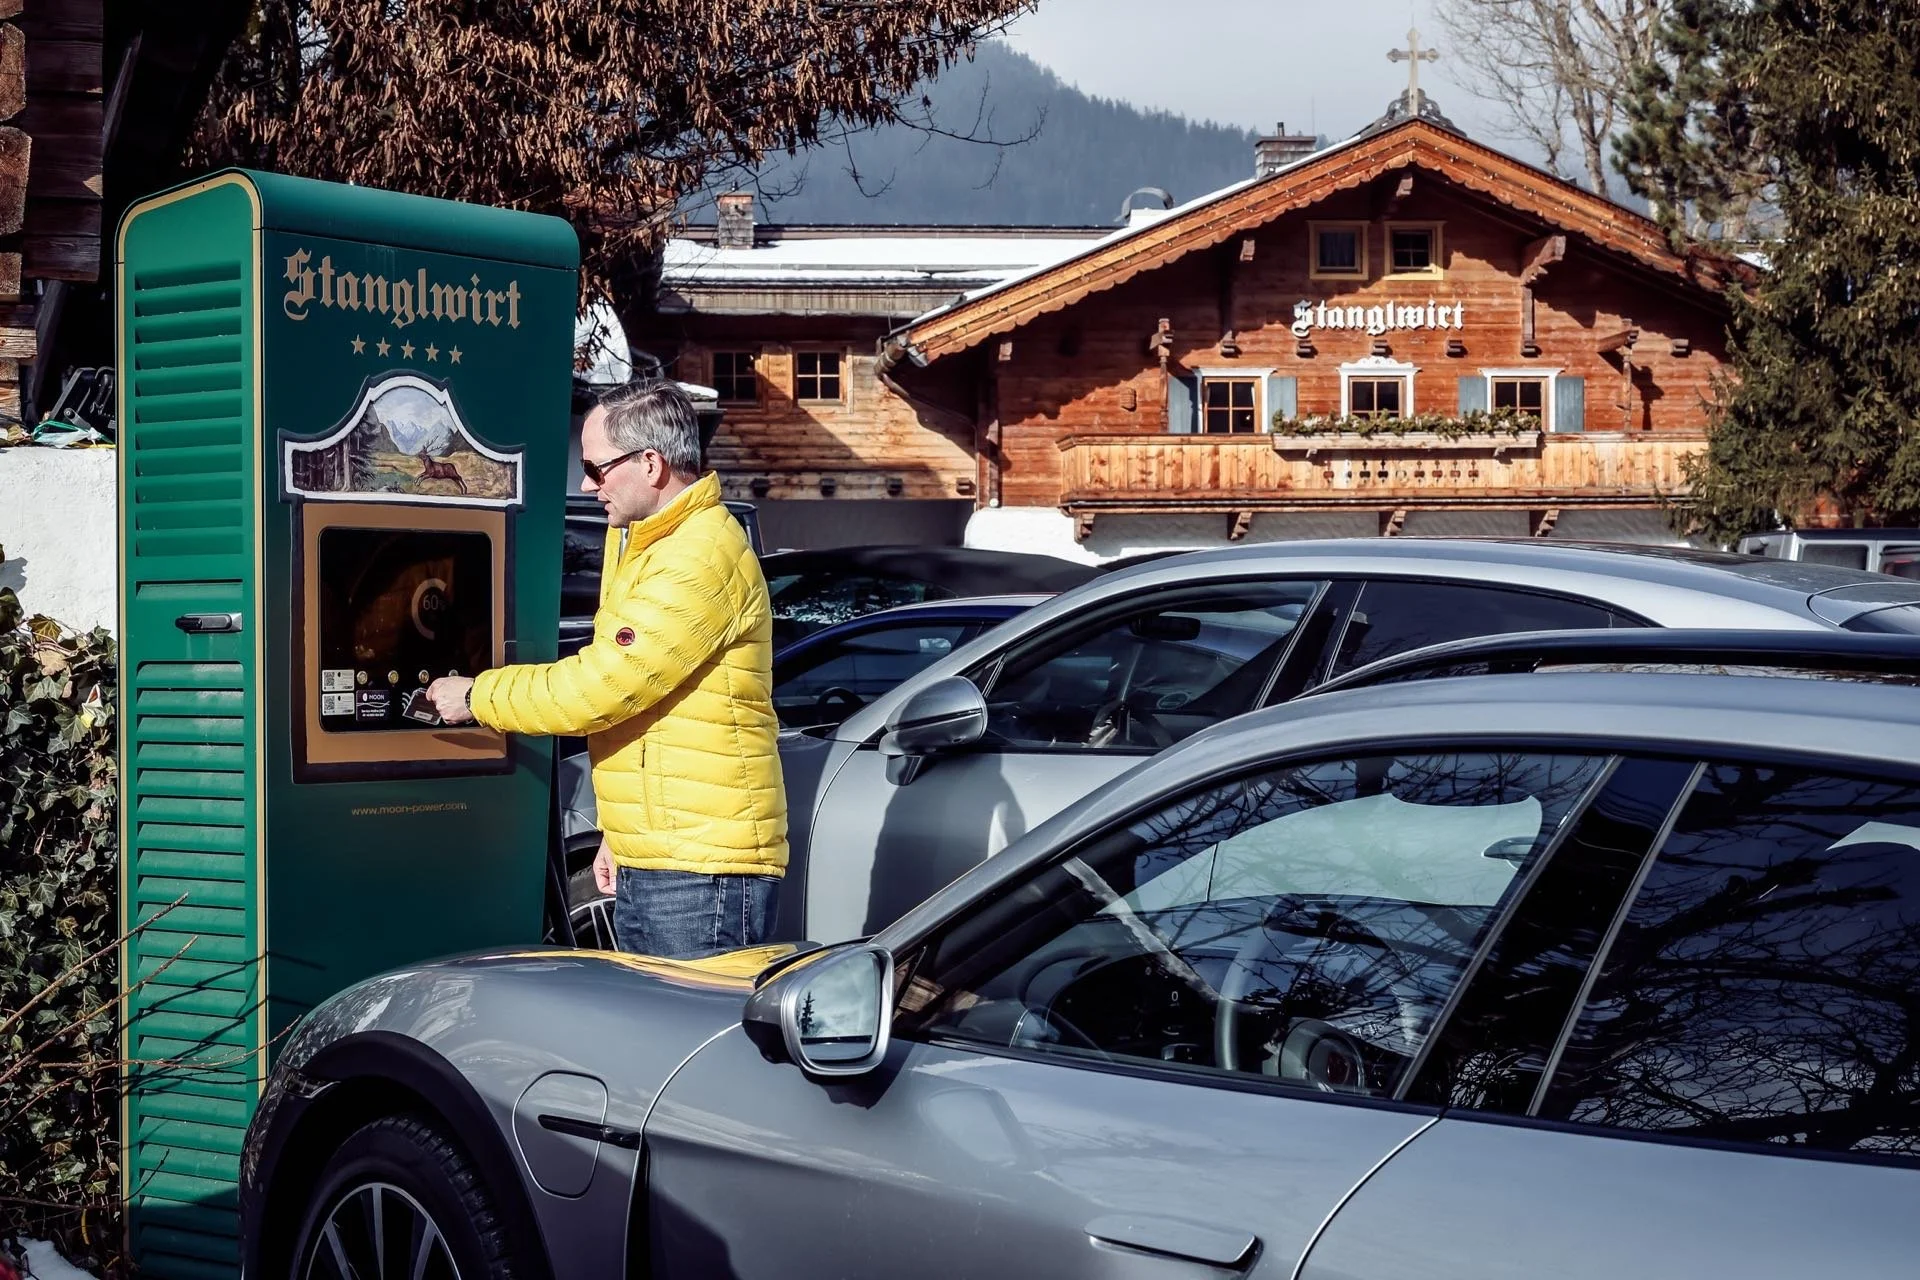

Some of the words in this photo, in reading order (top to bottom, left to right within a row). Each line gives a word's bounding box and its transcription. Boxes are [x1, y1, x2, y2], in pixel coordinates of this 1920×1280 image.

[283, 247, 521, 329] Stanglwirt
[1291, 299, 1465, 337] Stanglwirt
[351, 803, 467, 816] www.moon-power.com
